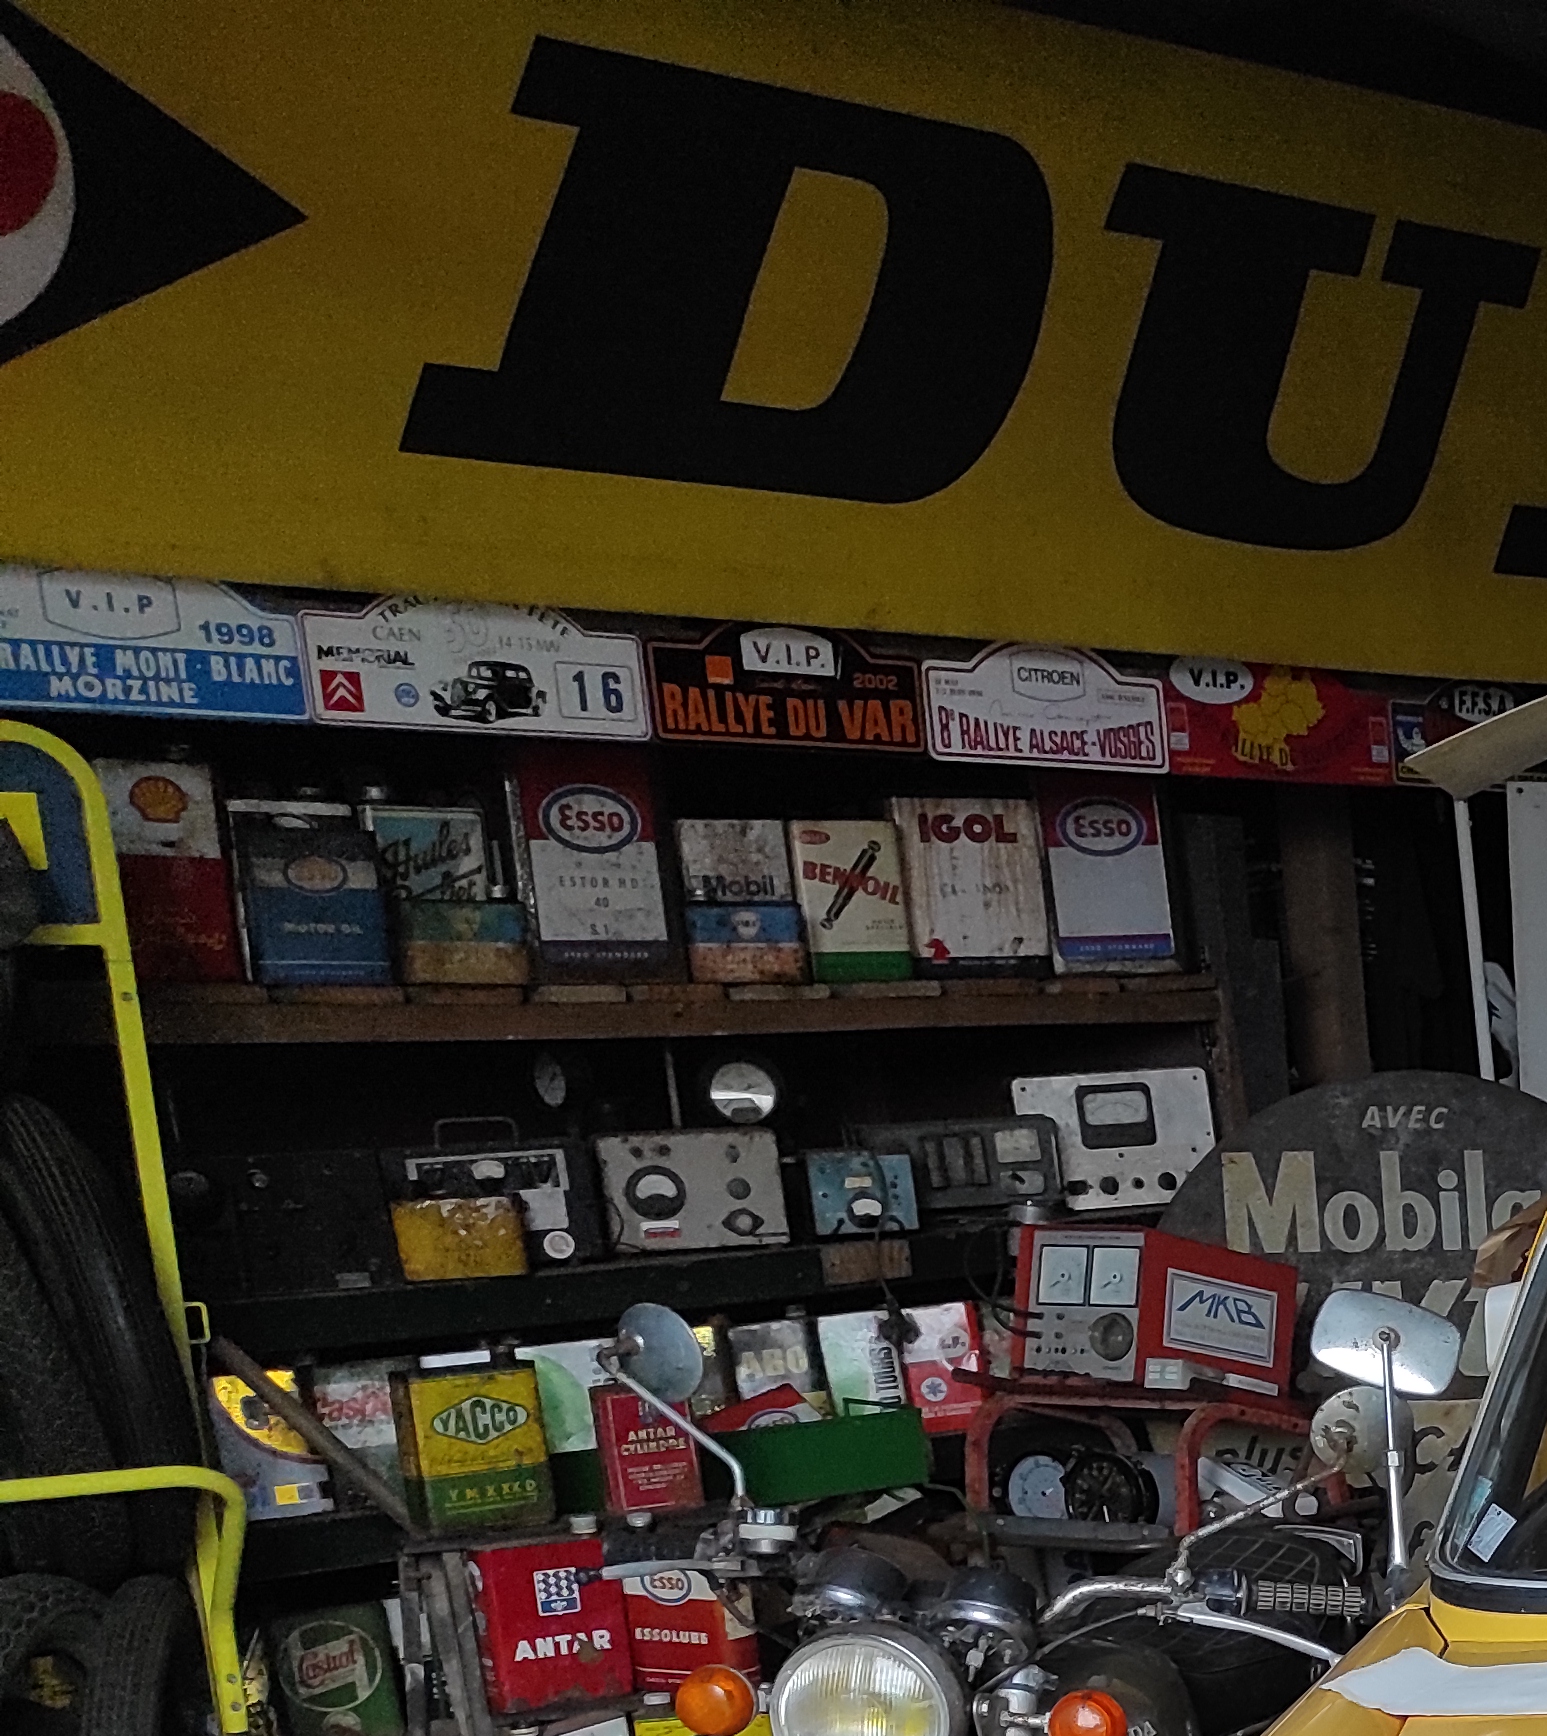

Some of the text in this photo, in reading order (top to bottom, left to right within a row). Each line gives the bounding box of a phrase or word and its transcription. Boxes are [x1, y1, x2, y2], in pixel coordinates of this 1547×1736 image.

[200, 620, 277, 648] 1998
[0, 642, 98, 674] RALLYE
[752, 640, 826, 669] V.I.P.
[50, 675, 199, 704] MORZINE
[853, 671, 898, 691] 2002
[1017, 666, 1081, 686] CITROEN
[1189, 667, 1246, 691] V.I.P.
[661, 681, 916, 743] RALLYE DU VAR
[959, 710, 1023, 754] RALLYE
[1029, 720, 1157, 761] ALSACE-VOSGES
[917, 812, 1018, 843] IGOL
[1361, 1105, 1450, 1130] AVEC
[1176, 1288, 1266, 1330] MKB
[441, 1398, 518, 1442] YACCO
